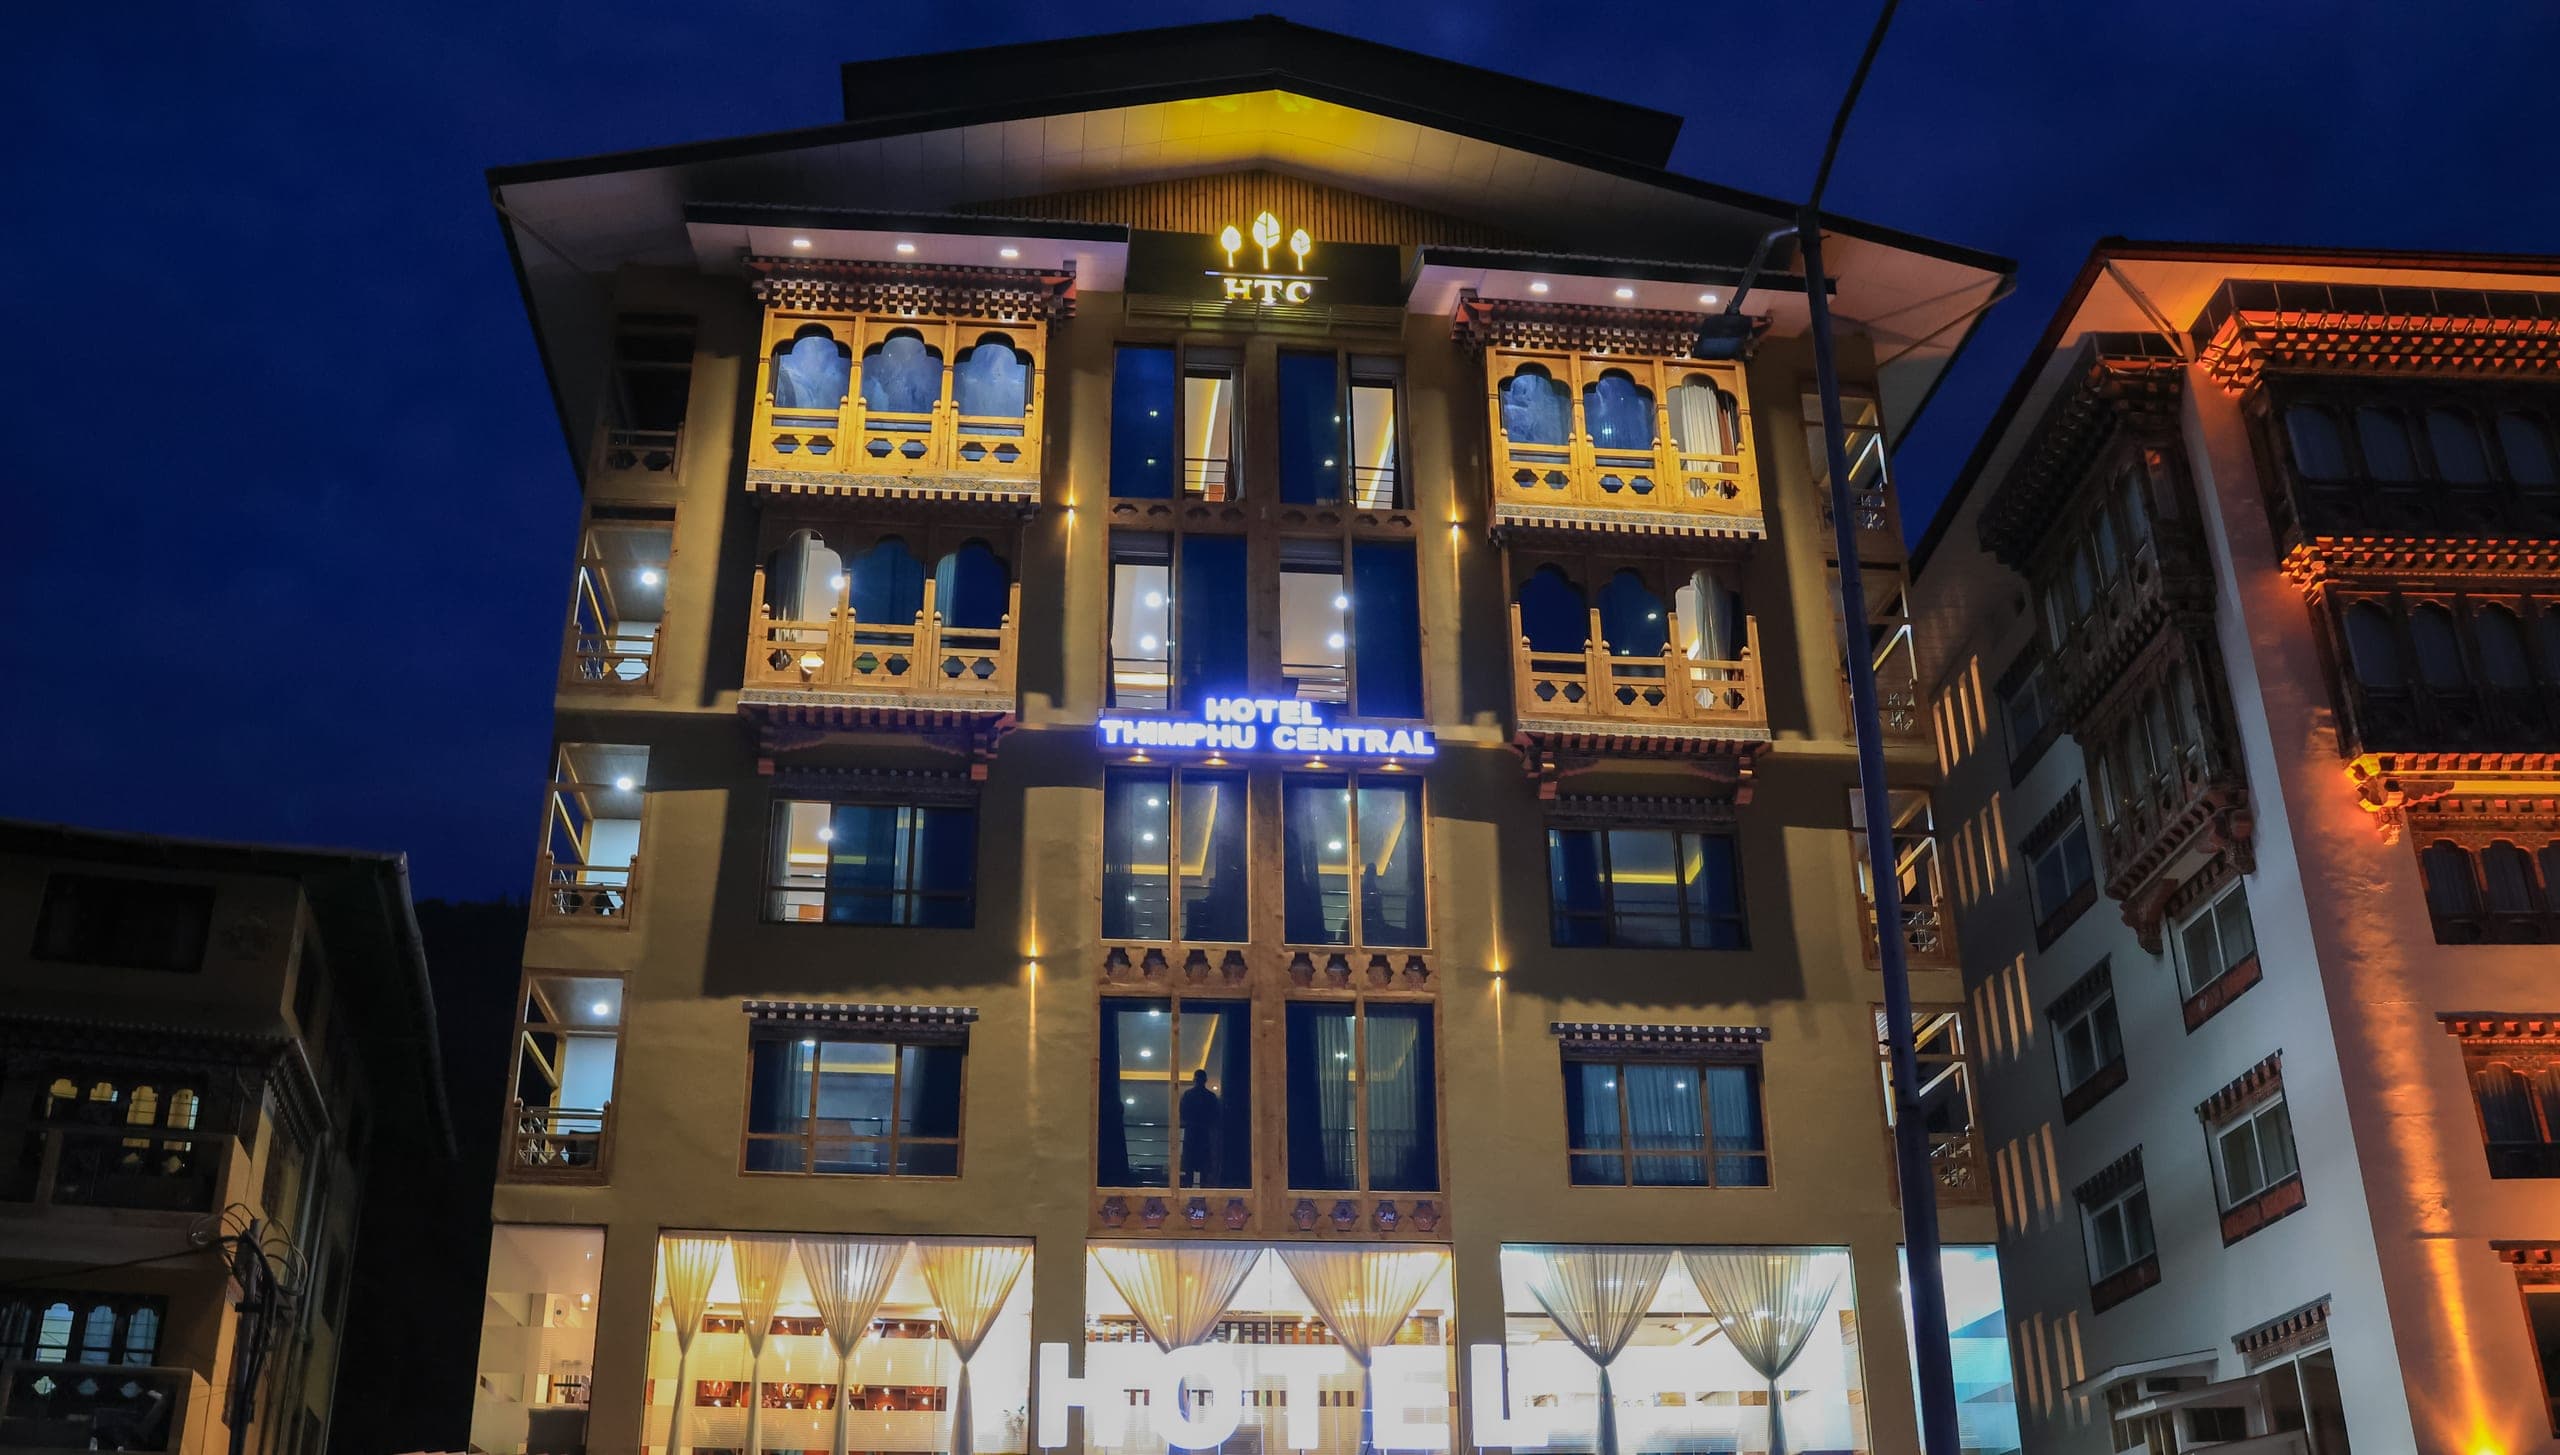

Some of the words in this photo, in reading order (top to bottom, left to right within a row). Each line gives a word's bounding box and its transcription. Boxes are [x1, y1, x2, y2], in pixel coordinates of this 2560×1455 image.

[1224, 279, 1312, 304] HTC
[1205, 697, 1323, 725] HOTEL
[1100, 719, 1257, 749] THIMPHU
[1272, 726, 1435, 755] CENTRAL
[1037, 1342, 1550, 1450] HOTEL
